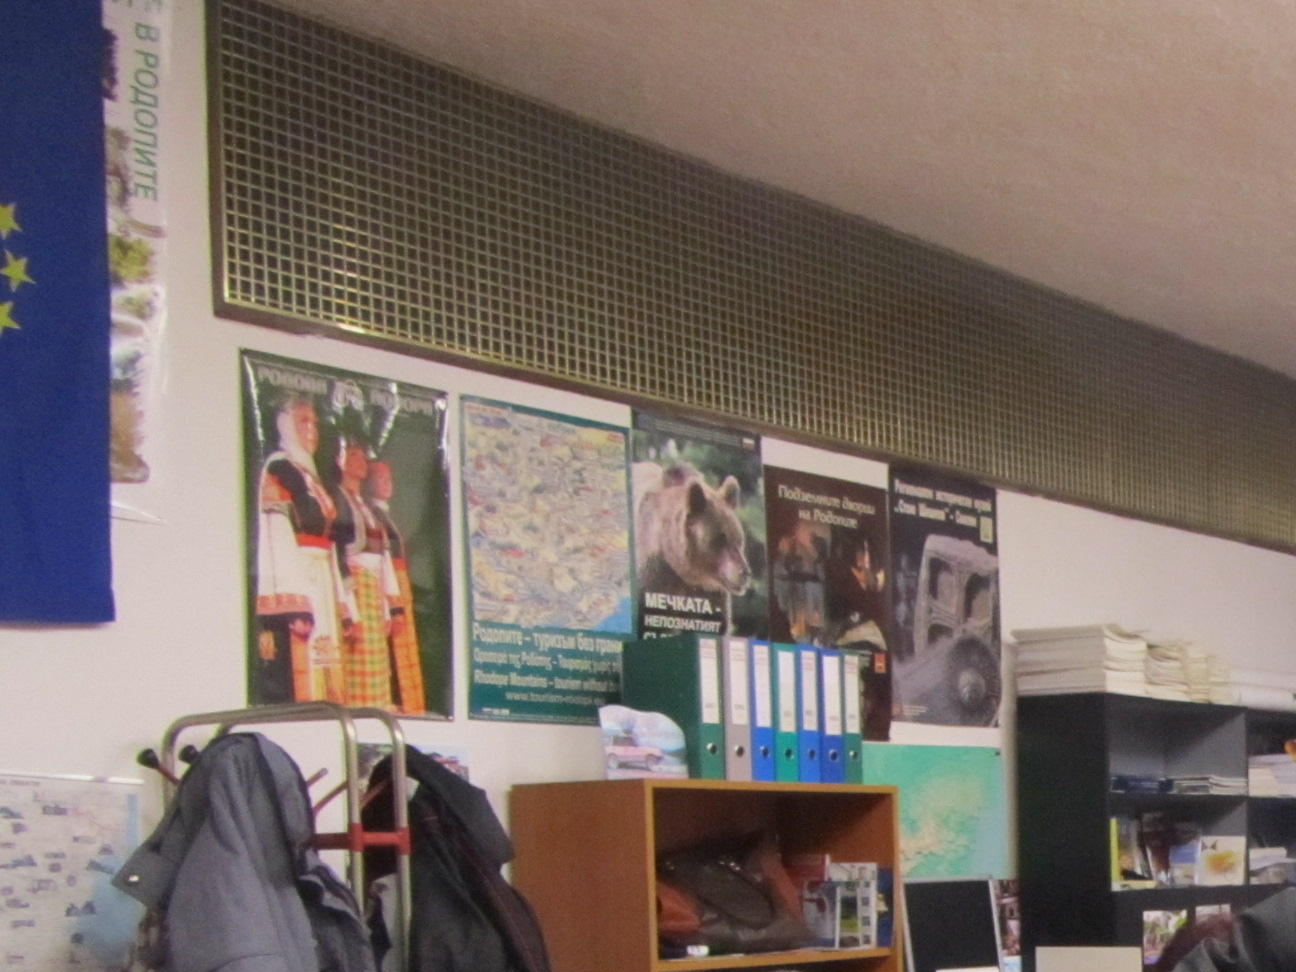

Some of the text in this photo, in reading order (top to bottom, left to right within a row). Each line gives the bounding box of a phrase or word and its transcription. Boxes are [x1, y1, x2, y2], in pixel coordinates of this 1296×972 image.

[134, 22, 161, 42] В
[130, 49, 159, 202] РОДОПИТЕ
[645, 592, 713, 614] МЕЧКАТА
[473, 622, 523, 645] Родопите
[644, 614, 721, 632] НЕПОЗНАТИЯТ
